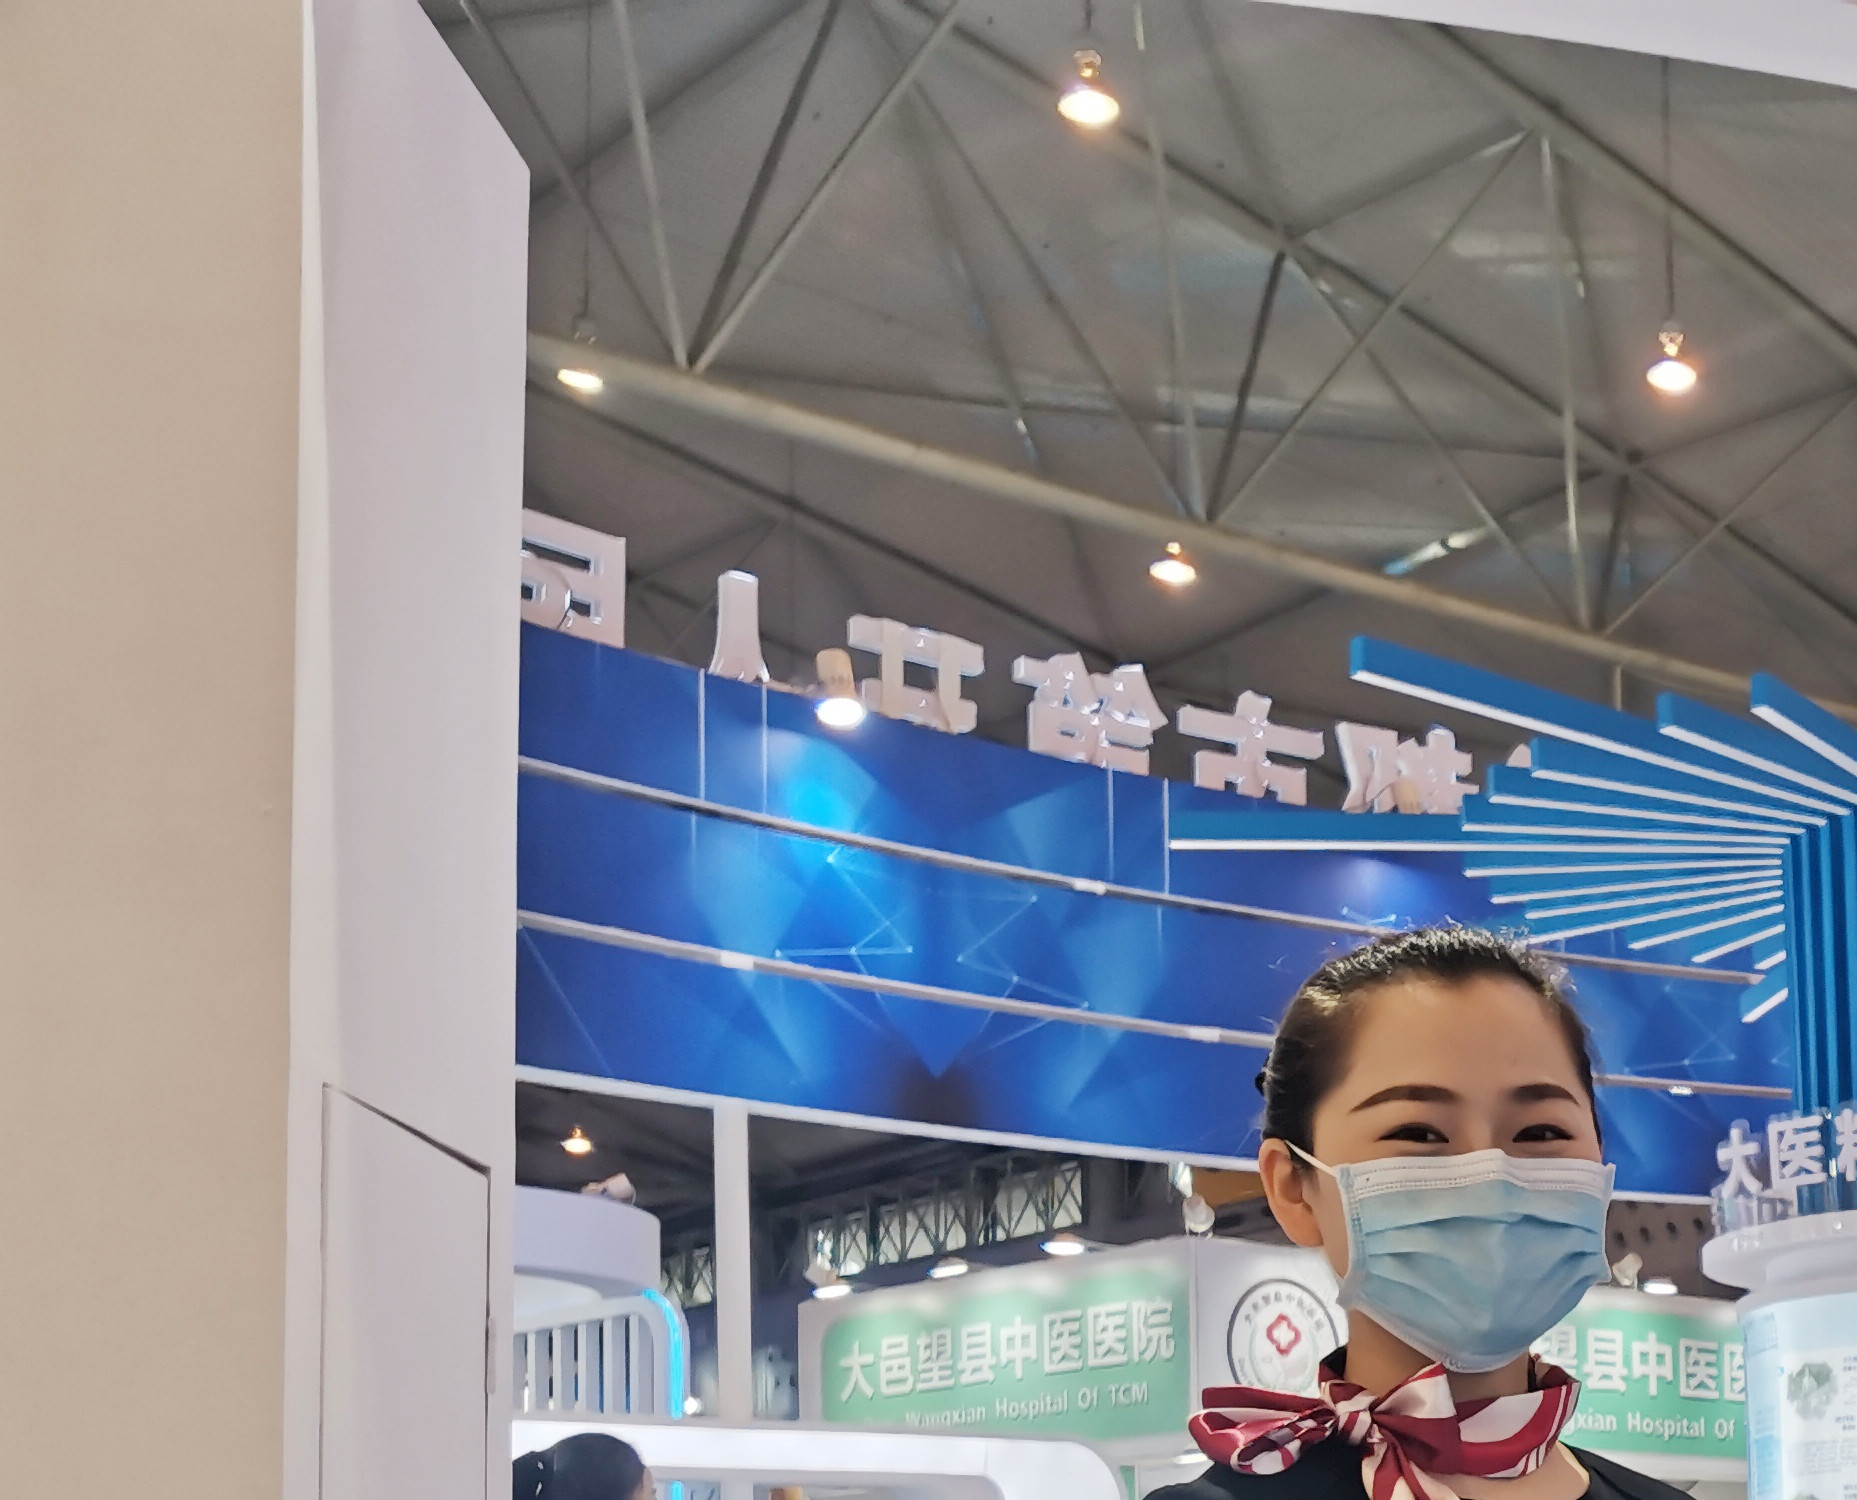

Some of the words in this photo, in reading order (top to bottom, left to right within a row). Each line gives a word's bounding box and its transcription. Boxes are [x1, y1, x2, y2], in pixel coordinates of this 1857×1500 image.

[839, 1299, 1177, 1403] 大邑望县中医医院
[996, 1389, 1069, 1421] Hospital
[1077, 1385, 1099, 1409] Of
[1108, 1381, 1149, 1407] TCM
[1627, 1410, 1706, 1441] Hospital
[1714, 1418, 1736, 1440] Of
